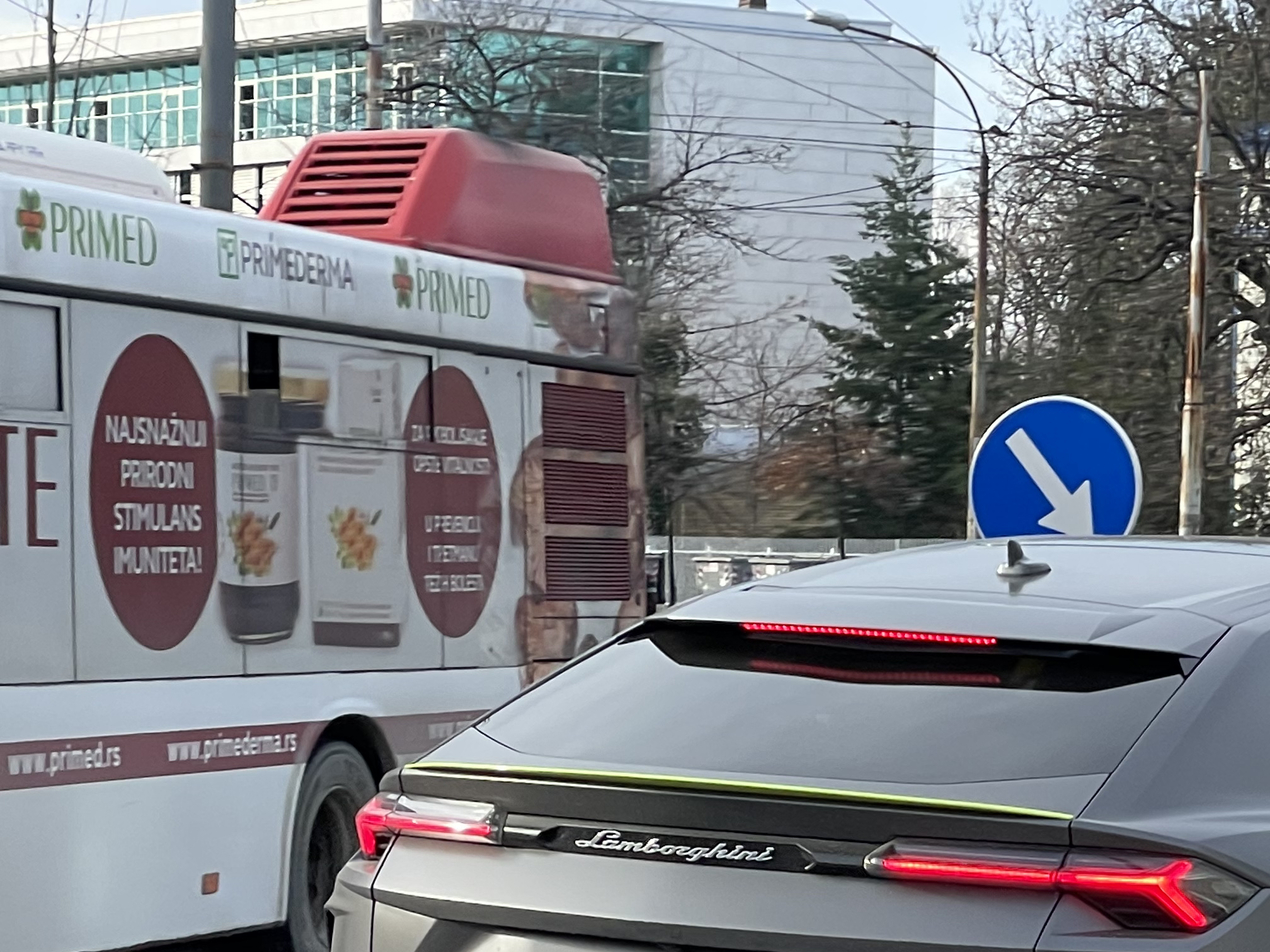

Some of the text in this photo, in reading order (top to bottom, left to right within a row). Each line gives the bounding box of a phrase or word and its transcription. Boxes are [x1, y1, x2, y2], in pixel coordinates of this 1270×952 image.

[50, 202, 157, 267] PRIMED
[240, 240, 356, 291] PRIMEDERMA
[416, 267, 491, 320] PRIMED
[120, 459, 195, 489] PRIRODNI
[113, 502, 202, 532] STIMULANS
[113, 545, 203, 574] IMUNITETA!
[7, 742, 121, 777] www.primed.rs
[167, 731, 297, 763] www.primederma.rs
[575, 829, 775, 862] Lamborghini
